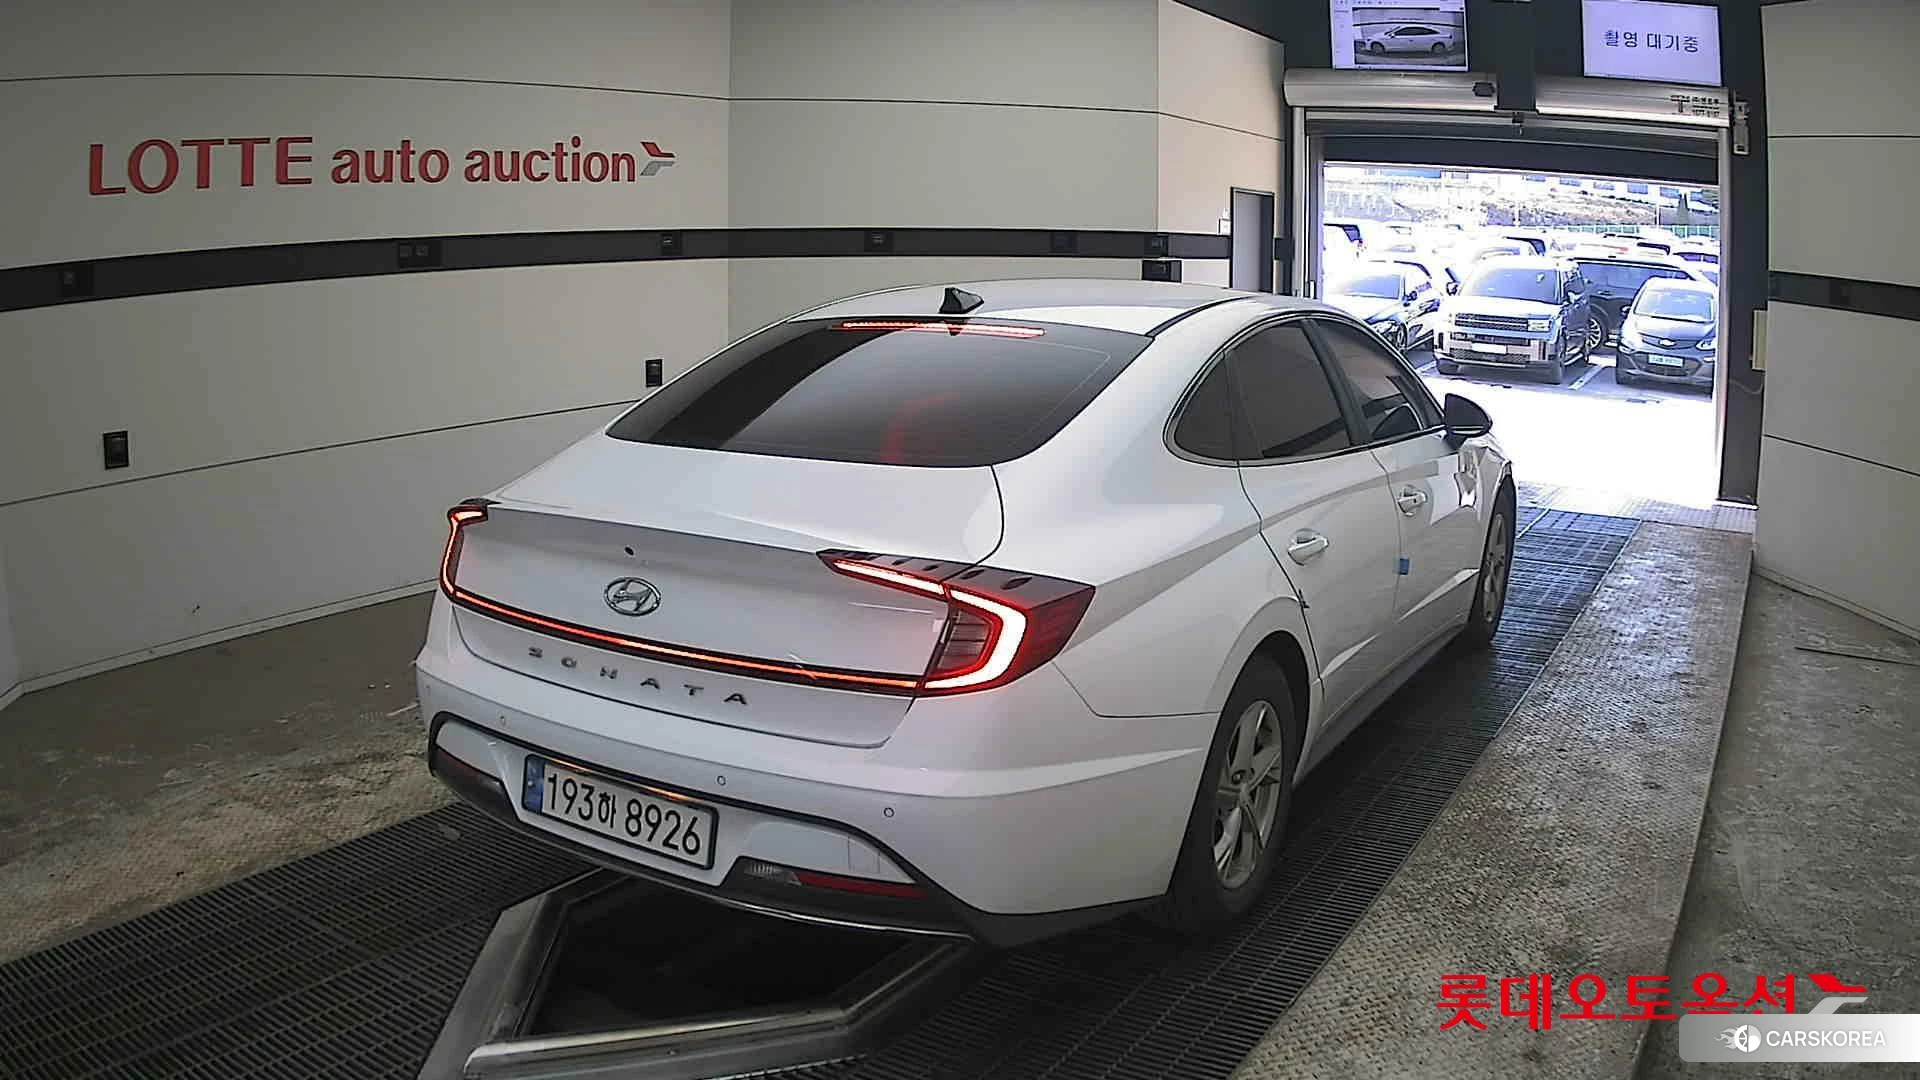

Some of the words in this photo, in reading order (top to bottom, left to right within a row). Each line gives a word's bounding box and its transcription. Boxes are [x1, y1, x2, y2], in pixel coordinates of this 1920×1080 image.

[1604, 30, 1638, 48] 촬영
[1646, 33, 1698, 52] 대기중
[89, 136, 313, 195] LOTTE
[331, 140, 450, 184] auto
[464, 136, 637, 183] auction
[528, 647, 748, 704] SONATA
[547, 773, 617, 829] 193하
[624, 798, 701, 856] 8926
